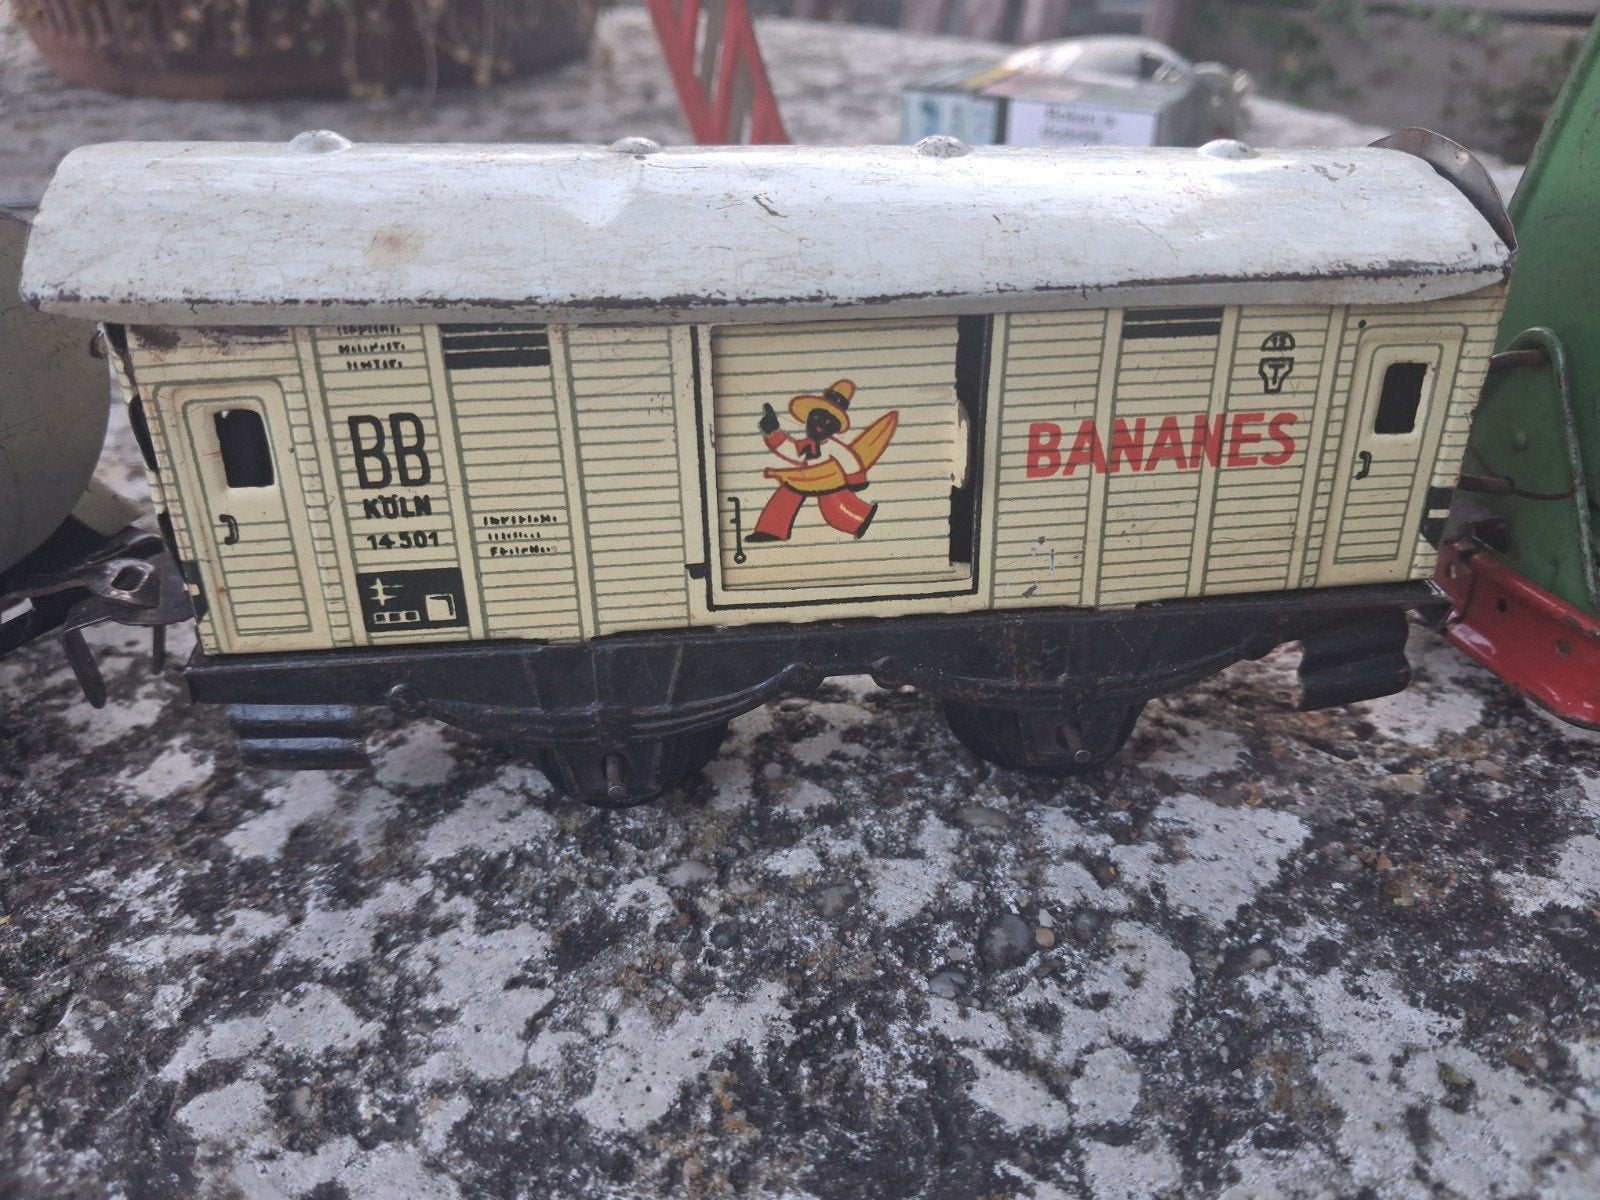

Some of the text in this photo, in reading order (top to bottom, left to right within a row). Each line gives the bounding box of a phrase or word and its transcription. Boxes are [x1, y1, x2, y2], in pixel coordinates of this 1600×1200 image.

[348, 412, 431, 489] BB
[1026, 412, 1298, 479] BANANES
[363, 494, 432, 519] KÖLN
